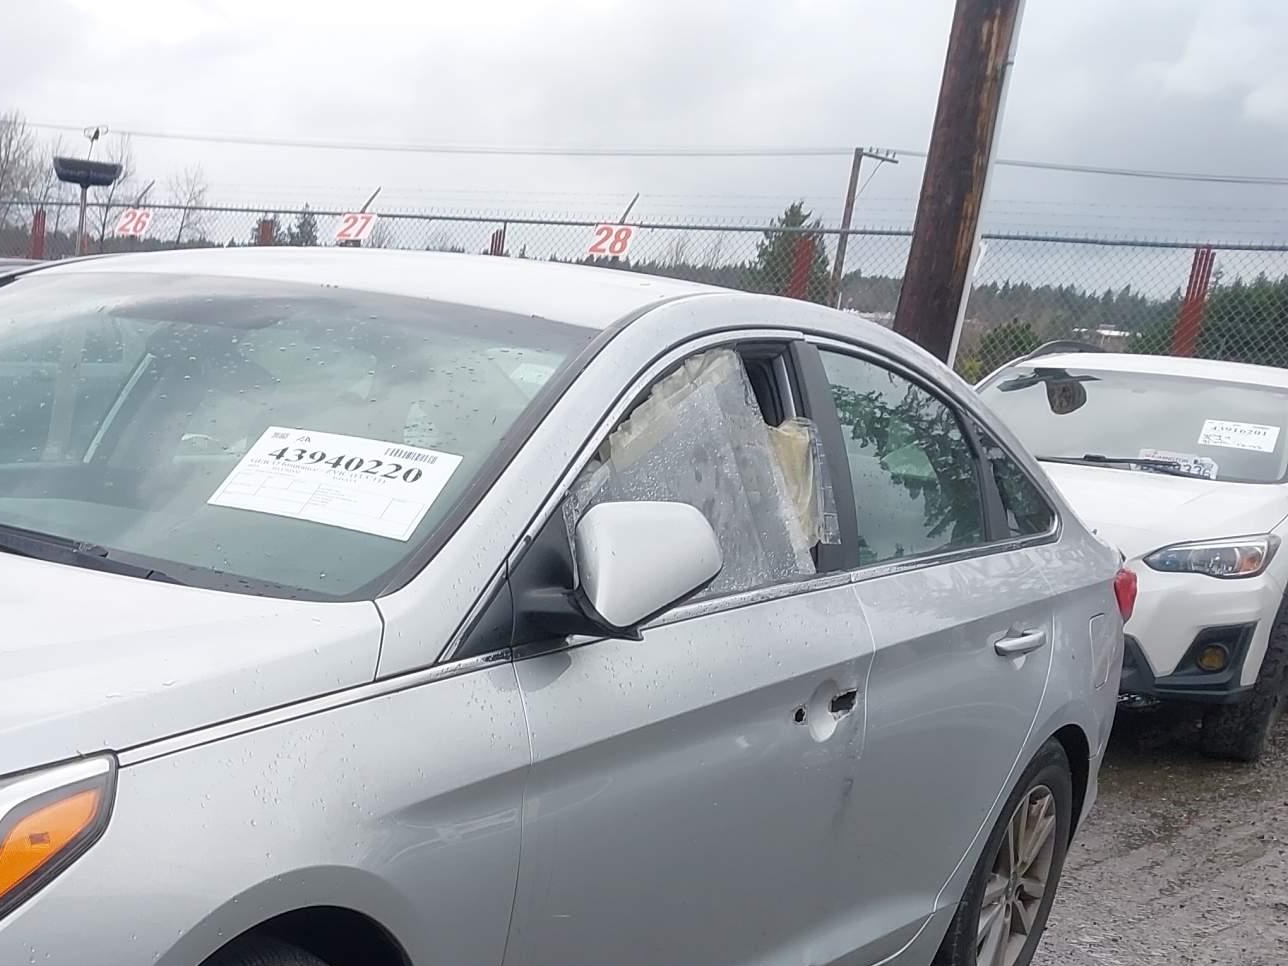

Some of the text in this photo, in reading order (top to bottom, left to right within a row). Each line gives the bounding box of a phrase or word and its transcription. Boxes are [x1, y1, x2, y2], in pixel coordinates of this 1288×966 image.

[119, 210, 150, 233] 26
[336, 214, 372, 238] 27
[588, 226, 632, 254] 28
[268, 446, 423, 483] 43940220
